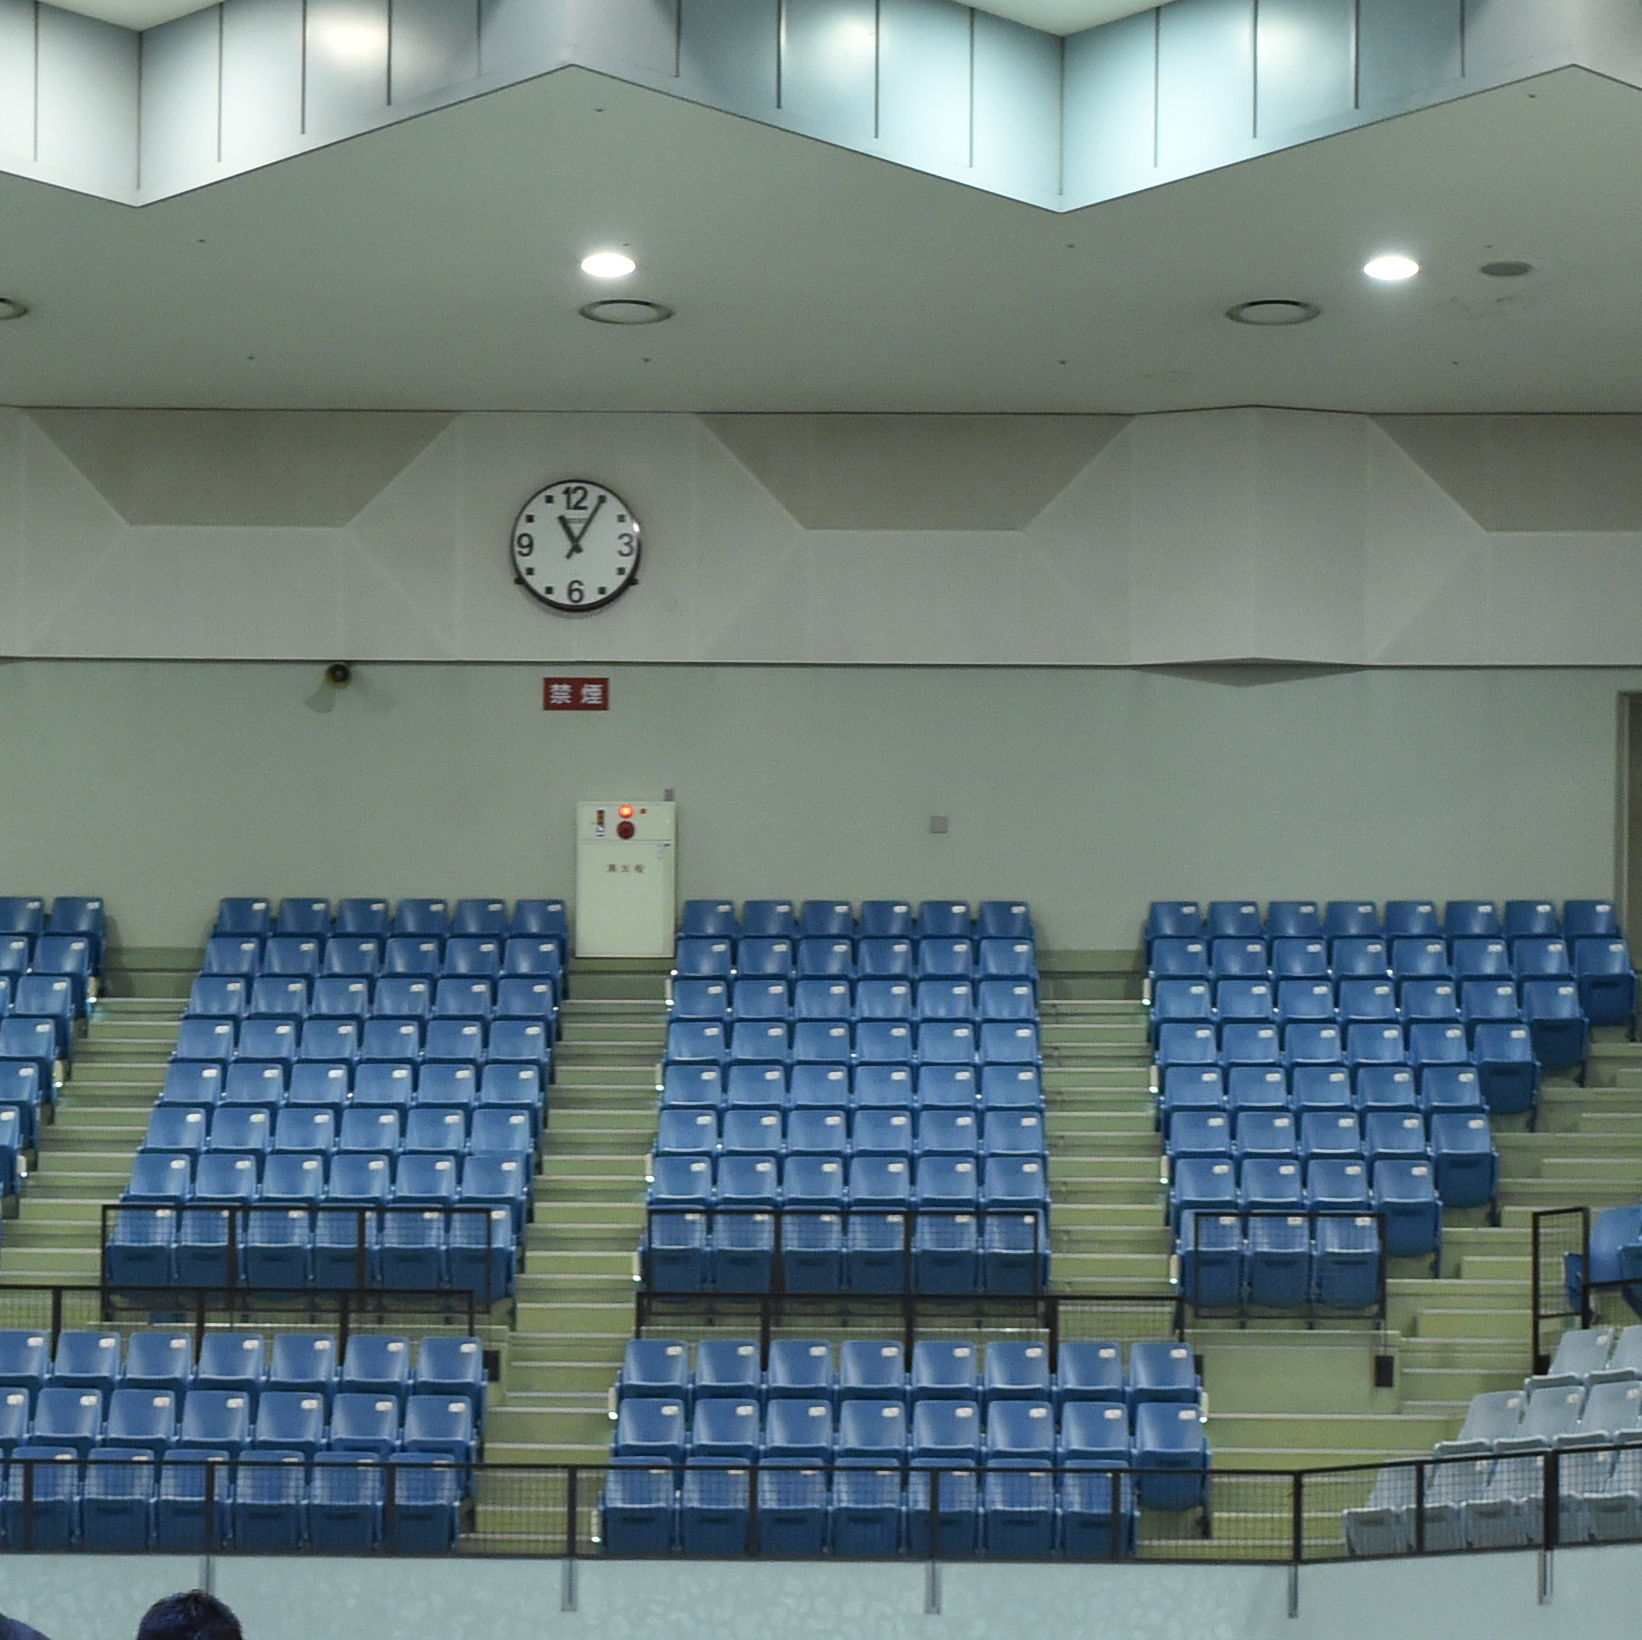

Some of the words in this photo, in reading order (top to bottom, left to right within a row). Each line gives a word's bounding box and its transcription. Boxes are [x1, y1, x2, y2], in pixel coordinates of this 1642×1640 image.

[562, 485, 589, 511] 12
[517, 532, 534, 557] 9
[617, 532, 634, 557] 3
[567, 579, 584, 604] 6
[549, 683, 604, 705] 禁煙
